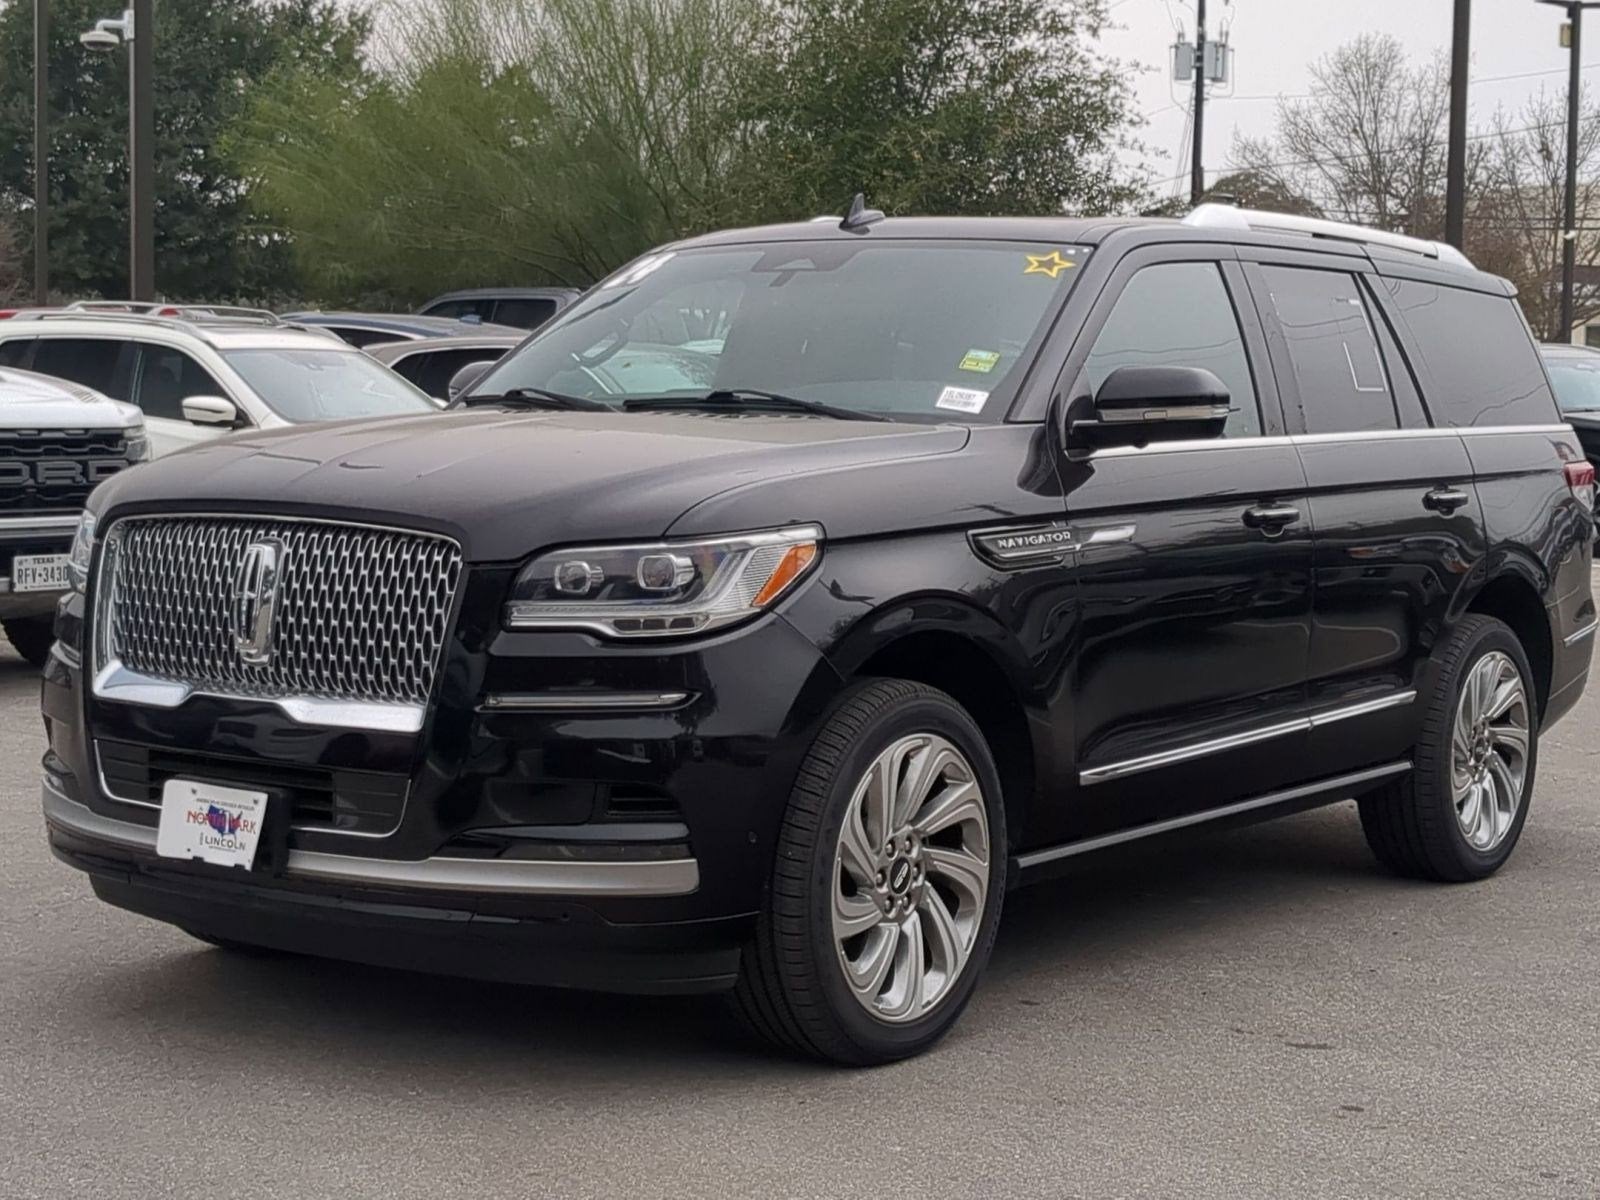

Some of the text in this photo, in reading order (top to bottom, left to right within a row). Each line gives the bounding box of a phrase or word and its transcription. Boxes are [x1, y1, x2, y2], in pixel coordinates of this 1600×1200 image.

[0, 460, 128, 484] ORD
[998, 531, 1071, 548] NAVIGATOR
[205, 836, 245, 851] LINCOLN
